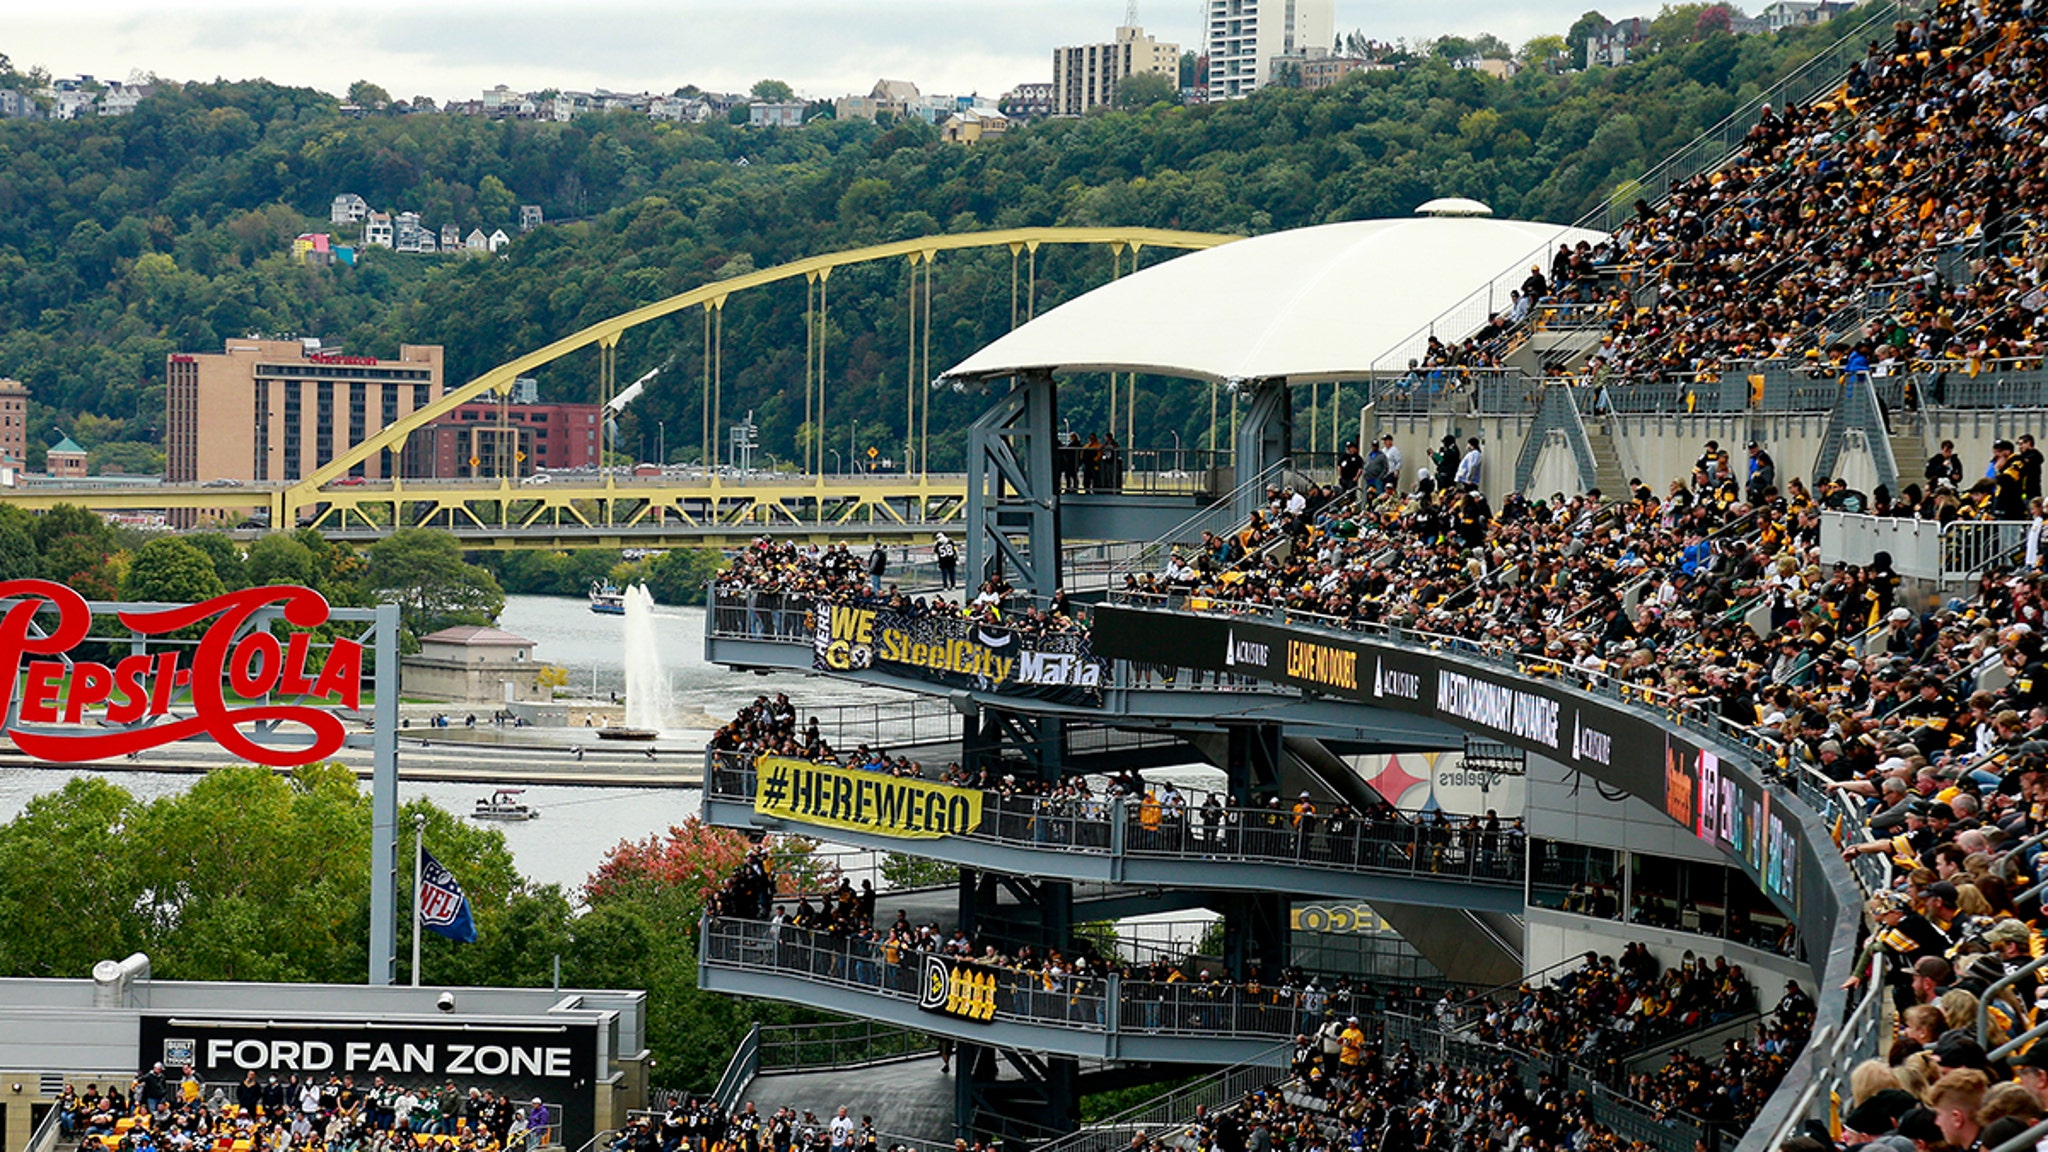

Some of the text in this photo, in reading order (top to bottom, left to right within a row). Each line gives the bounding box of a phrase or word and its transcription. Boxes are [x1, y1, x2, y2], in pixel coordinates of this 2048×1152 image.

[309, 352, 378, 366] Sheraton
[939, 543, 955, 557] 58
[814, 603, 830, 657] HERE
[831, 605, 876, 644] WE
[1287, 639, 1316, 681] LEAVE
[1315, 646, 1330, 685] NO
[1436, 669, 1450, 712] AN
[763, 765, 970, 836] #HEREWEGO
[420, 881, 453, 918] NFL
[207, 1038, 572, 1077] FORD FAN ZONE
